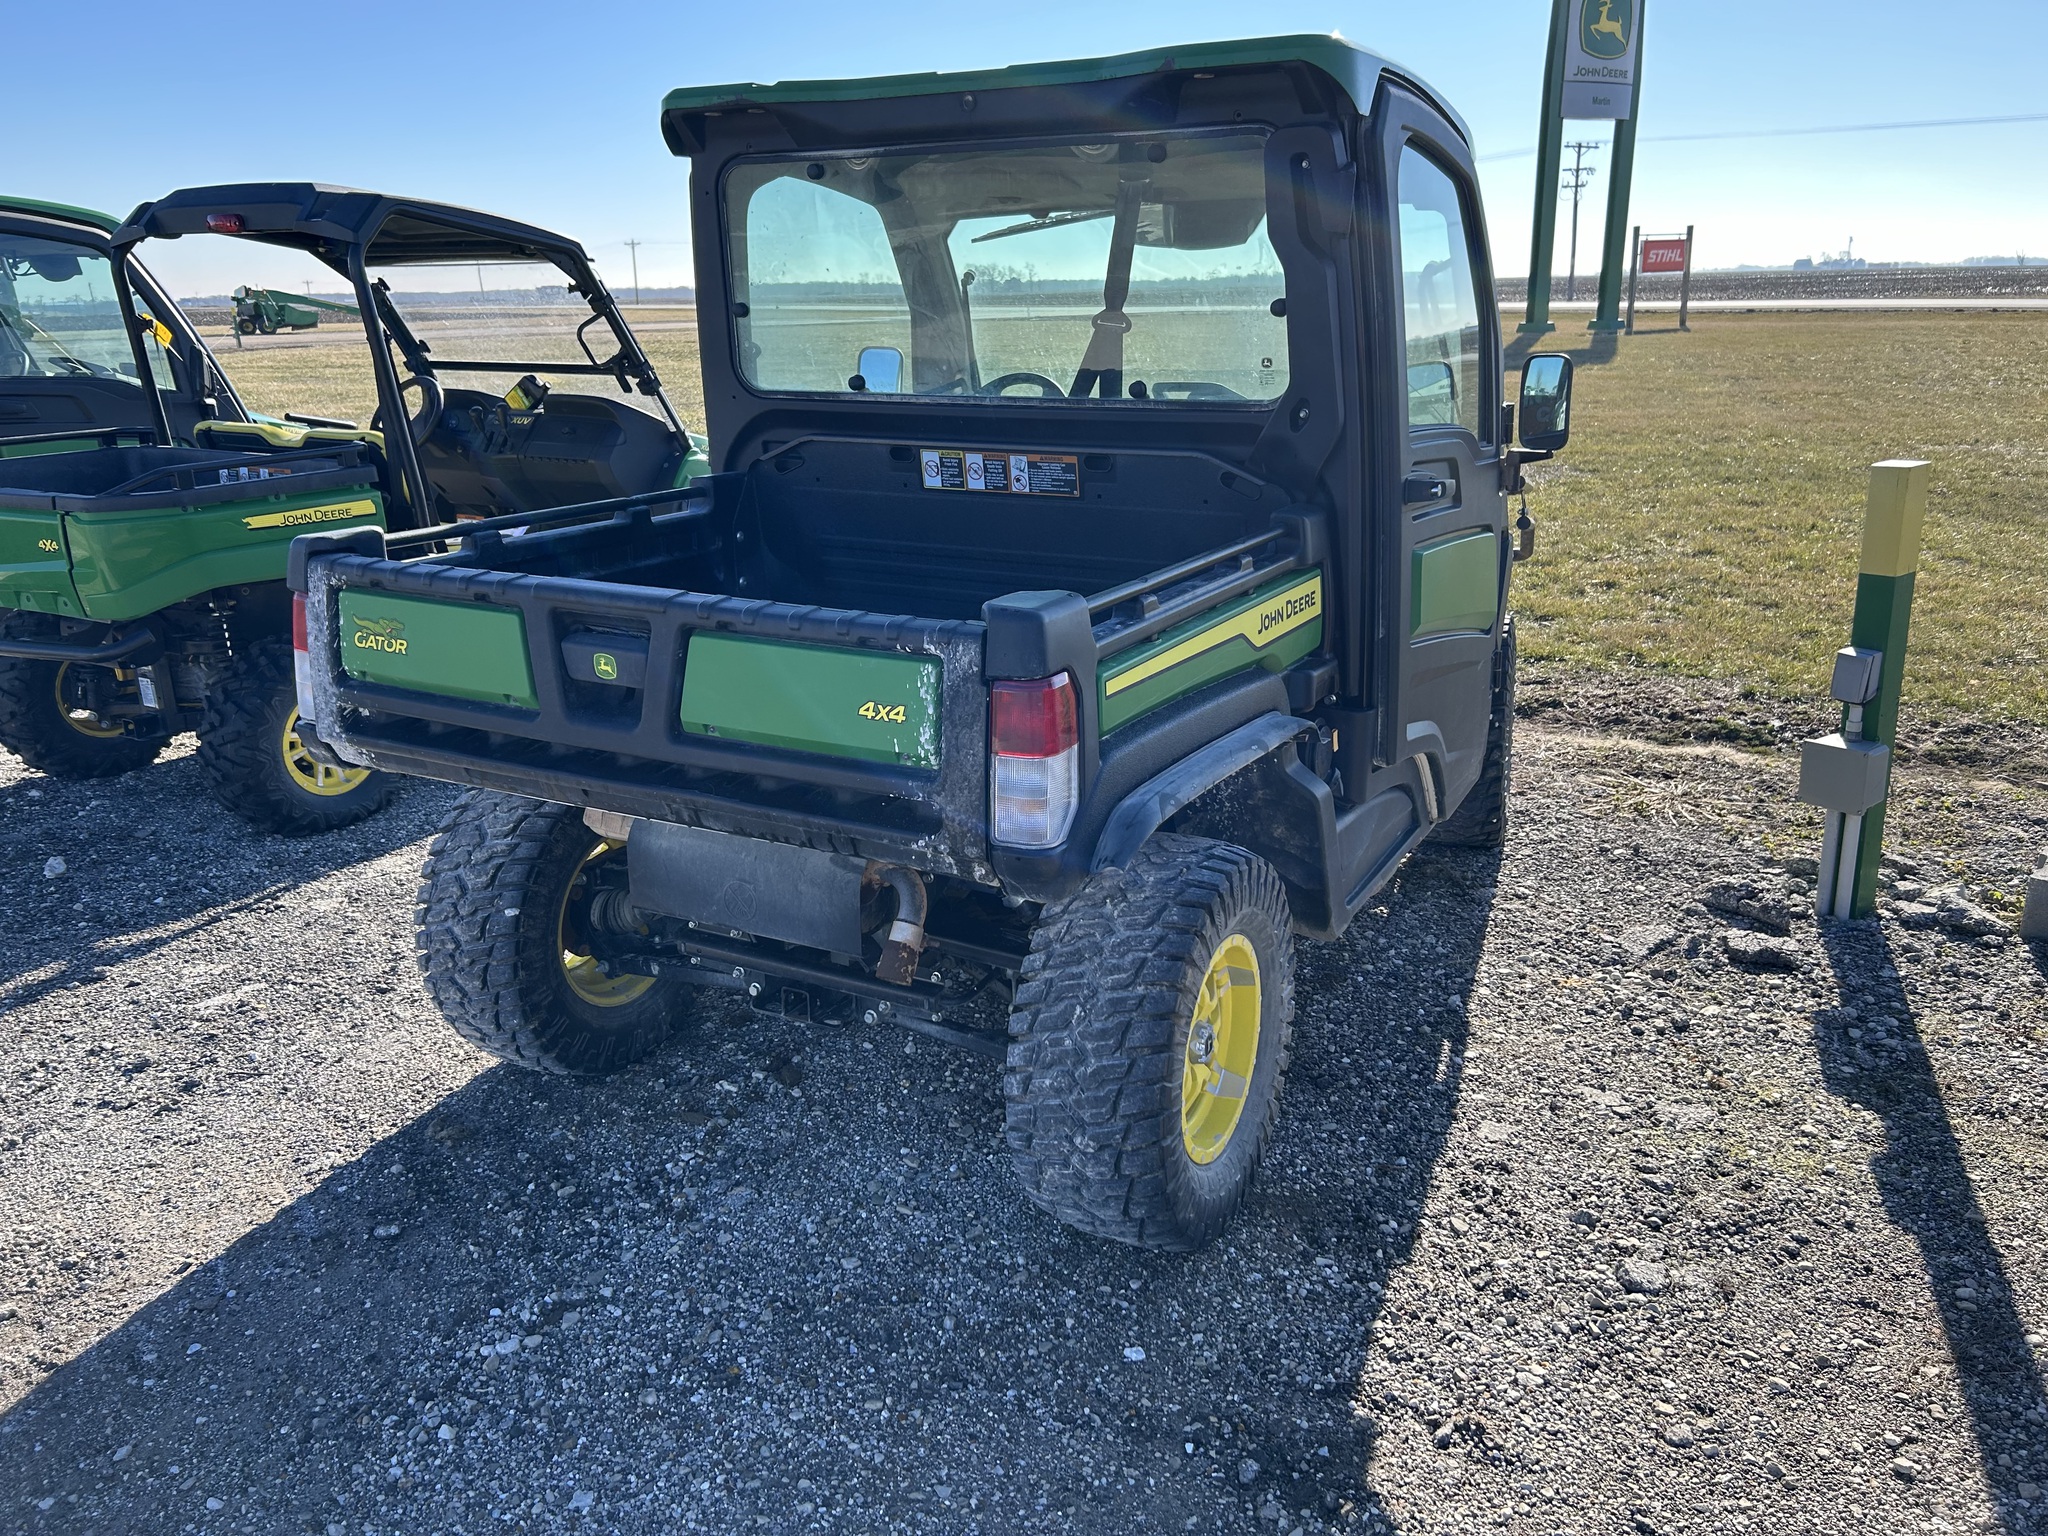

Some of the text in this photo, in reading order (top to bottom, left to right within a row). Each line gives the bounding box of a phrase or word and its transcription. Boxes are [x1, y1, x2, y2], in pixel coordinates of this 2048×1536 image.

[1573, 65, 1628, 79] JOHN DEERE
[1647, 249, 1683, 263] STIHL
[511, 416, 532, 425] XUV
[280, 508, 353, 526] JOHN DEERE
[1258, 590, 1316, 635] JOHN DEERE
[354, 631, 408, 655] GATOR
